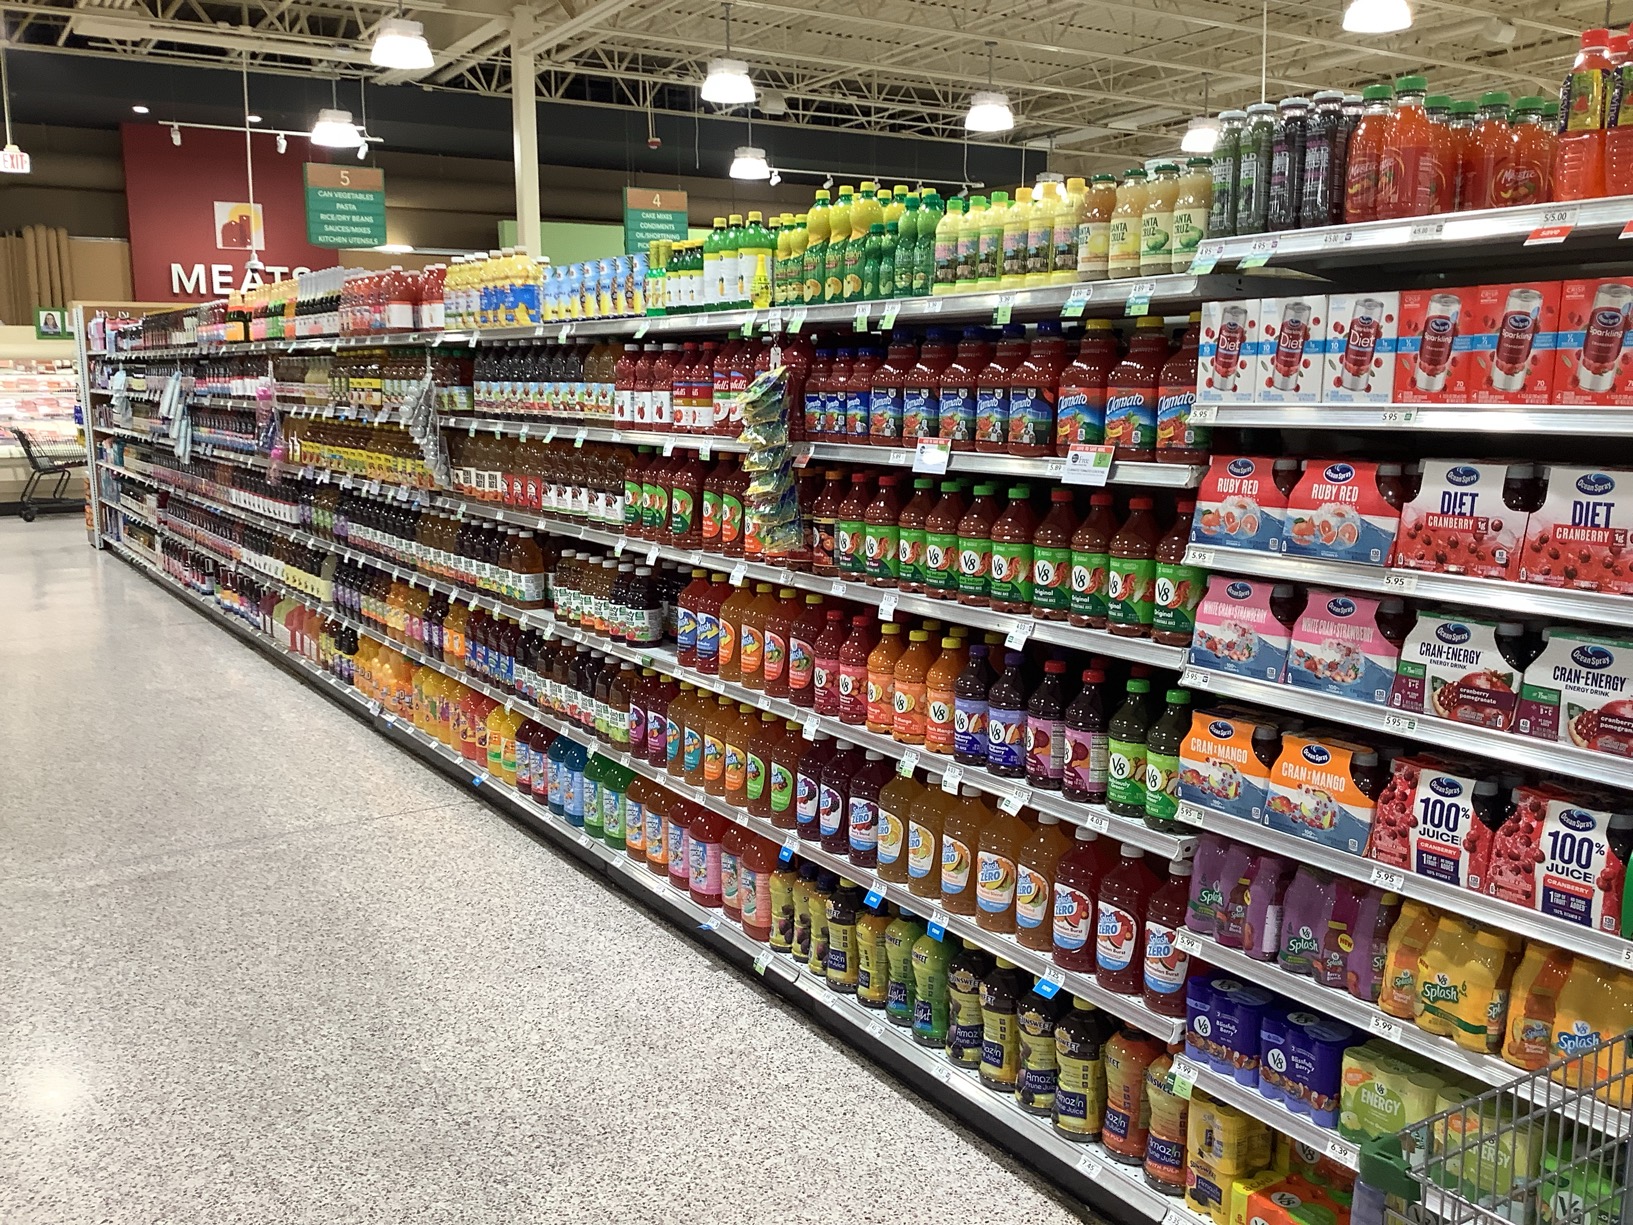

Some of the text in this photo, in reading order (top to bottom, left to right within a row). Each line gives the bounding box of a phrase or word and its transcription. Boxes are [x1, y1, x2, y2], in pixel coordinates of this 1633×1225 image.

[3, 154, 24, 169] EXIT
[340, 170, 350, 185] 5
[334, 192, 374, 200] VEGETABLES
[652, 193, 661, 207] 4
[324, 225, 371, 234] SAUCES/MIXES
[640, 222, 675, 230] CONDIMENTS
[349, 237, 378, 245] UTENSILS
[636, 232, 680, 240] OIL/SHORTENING
[1350, 329, 1375, 347] Diet
[1425, 332, 1452, 343] Sparkling
[1502, 328, 1532, 340] Sparkling
[1589, 326, 1623, 338] Sparkling
[1219, 334, 1240, 350] Diet
[1280, 332, 1304, 348] Diet
[940, 397, 963, 411] Clamato
[1107, 393, 1144, 415] Clamato
[1158, 391, 1196, 414] Clamato
[1217, 478, 1259, 494] RUBY RED
[1312, 484, 1358, 501] RUBY RED
[1441, 491, 1479, 516] DIET
[1572, 501, 1615, 528] DIET
[1428, 516, 1474, 530] CRANBERRY
[1556, 528, 1609, 543] CRANBERRY
[1614, 533, 1624, 544] 1g
[929, 548, 940, 565] V8
[963, 554, 976, 571] V8
[994, 559, 1003, 576] V8
[1036, 564, 1050, 581] V8
[1074, 569, 1085, 586] V8
[1386, 577, 1405, 585] 5.95
[1072, 595, 1089, 603] Original
[1158, 583, 1170, 601] V8
[1154, 610, 1173, 618] Original
[1204, 601, 1218, 615] WHITE
[1302, 618, 1319, 635] WHITE
[1437, 628, 1469, 641] Ocean Spray
[1419, 642, 1481, 664] CRAN-ENERGY
[1573, 651, 1611, 665] Ocean Spray
[1430, 659, 1467, 670] ENERGY DRINK
[815, 671, 823, 684] V8
[840, 678, 849, 691] V8
[1553, 666, 1627, 692] CRAN-ENERGY
[1460, 687, 1490, 698] cranberry
[1565, 684, 1610, 697] ENERGY DRINK
[895, 696, 904, 711] V8
[1460, 693, 1497, 705] pomegranate
[933, 705, 944, 720] V8
[955, 714, 965, 730] V8
[1386, 717, 1401, 727] 5.95
[1387, 717, 1401, 727] 5.95
[990, 724, 1002, 740] V8
[1111, 760, 1125, 774] V8
[1148, 769, 1158, 786] V8
[1431, 780, 1461, 795] Ocean Spray
[852, 815, 869, 824] ZERO
[1181, 808, 1192, 817] 5.95
[1420, 797, 1470, 832] 100%
[1089, 816, 1103, 826] 4.03
[1560, 813, 1594, 830] Ocean Spray
[1419, 826, 1459, 846] JUICE
[1419, 841, 1457, 856] CRANBERRY
[1548, 830, 1605, 869] 100%
[980, 870, 1000, 881] ZERO
[1375, 870, 1395, 883] 5.95
[1546, 862, 1593, 884] JUICE
[1547, 878, 1590, 895] CRANBERRY
[1549, 891, 1554, 903] 1
[1056, 905, 1074, 915] ZERO
[1605, 917, 1614, 925] 130
[1099, 924, 1118, 935] ZERO
[1302, 928, 1310, 938] V8
[1180, 936, 1194, 947] 5.99
[1289, 939, 1318, 953] Splash
[1340, 938, 1353, 947] NEW
[1148, 946, 1170, 957] ZERO
[1437, 974, 1447, 985] V8
[1423, 985, 1458, 1001] Splash
[1197, 1019, 1209, 1033] V8
[1215, 1020, 1237, 1034] Blissfully
[1375, 1018, 1393, 1031] 5.99
[1575, 1024, 1588, 1035] V8
[1219, 1027, 1234, 1037] Berry
[1559, 1034, 1600, 1049] Splash
[1271, 1053, 1284, 1068] V8
[1291, 1056, 1314, 1071] Blissfully
[1177, 1063, 1191, 1073] 5.99
[1295, 1063, 1311, 1074] Berry
[1375, 1083, 1385, 1095] V8
[1361, 1087, 1400, 1116] ENERGY
[1066, 1105, 1084, 1114] Juice
[1110, 1124, 1125, 1134] Juice
[1302, 1145, 1316, 1160] V8
[1330, 1143, 1348, 1156] 6.39
[1160, 1152, 1180, 1164] Juice
[1082, 1160, 1094, 1171] 7.45
[1163, 1165, 1179, 1174] PULP
